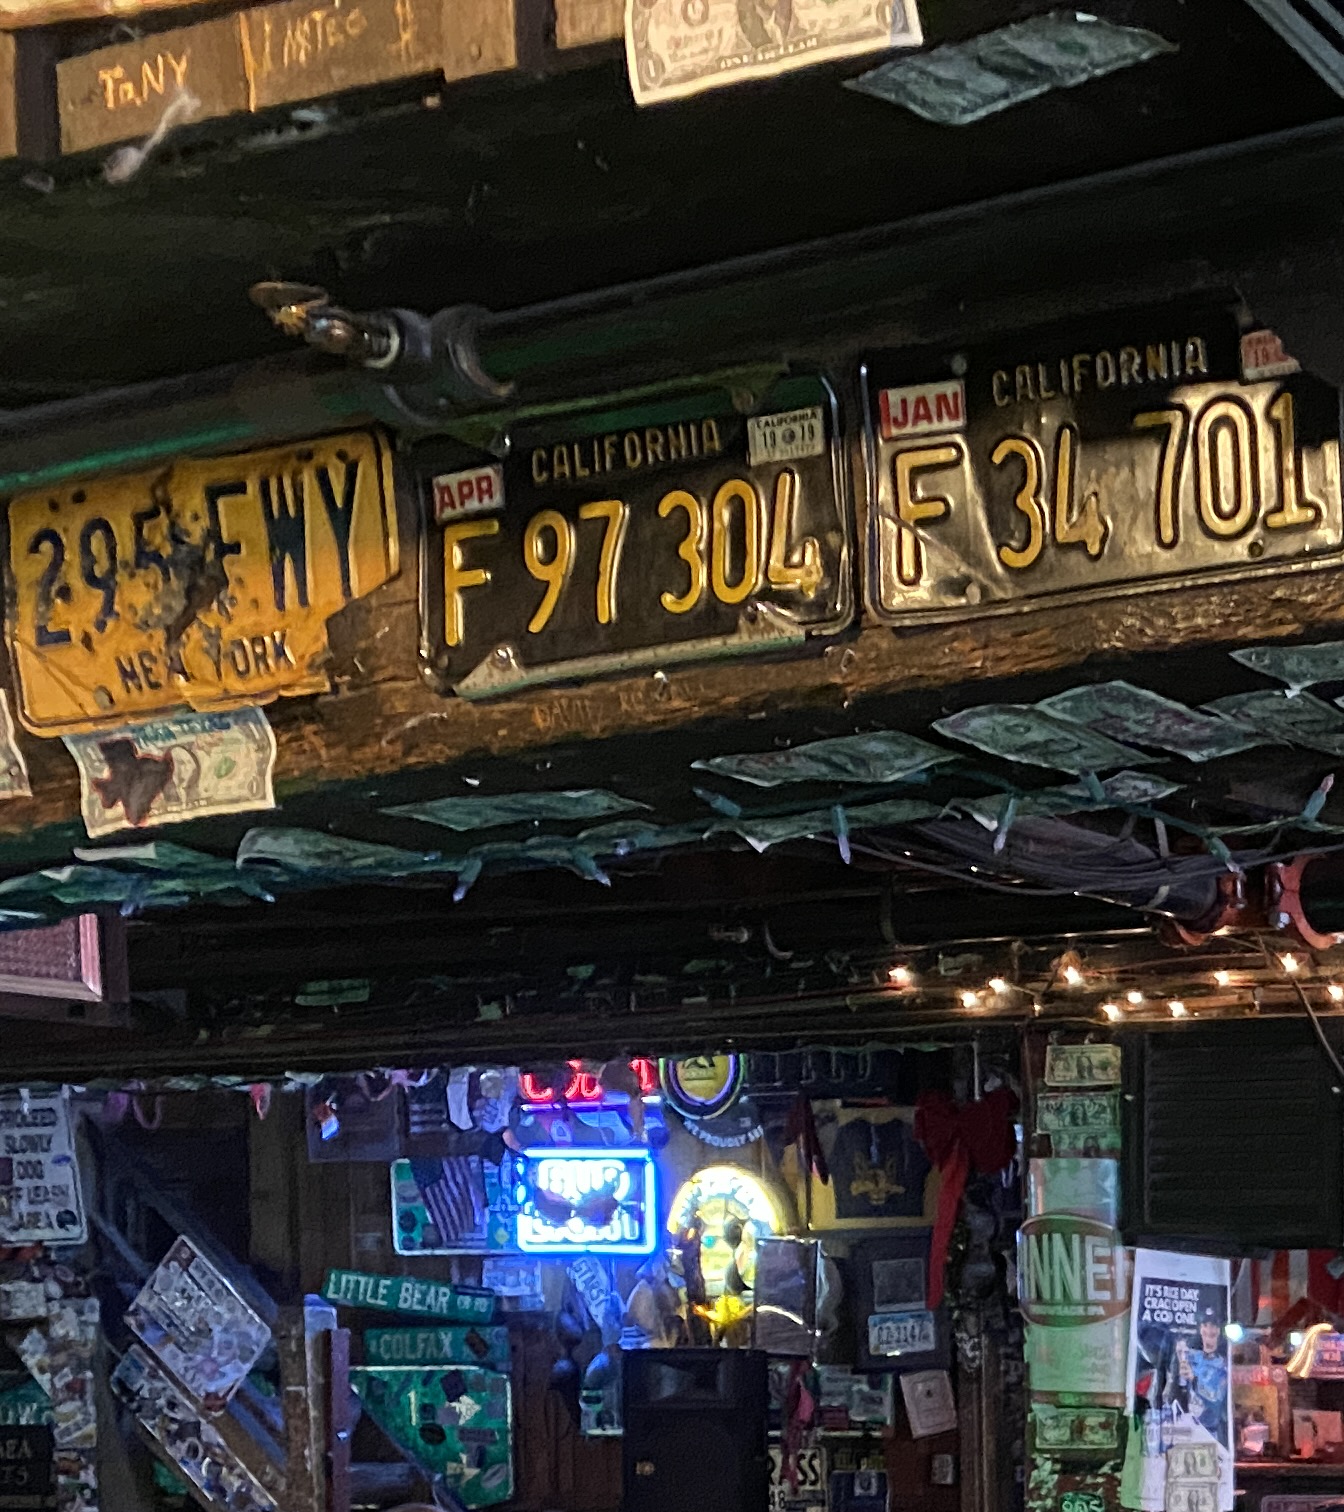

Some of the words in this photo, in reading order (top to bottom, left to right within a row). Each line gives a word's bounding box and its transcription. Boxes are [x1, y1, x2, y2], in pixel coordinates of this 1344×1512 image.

[991, 335, 1209, 408] CALIFORNIA
[890, 391, 962, 430] JAN
[531, 417, 722, 485] CALIFORNIA
[435, 472, 497, 515] APR
[892, 445, 962, 585] F
[991, 425, 1112, 570] 34
[1132, 388, 1318, 552] 701
[444, 518, 500, 648] F
[523, 498, 633, 635] 97
[657, 466, 824, 617] 304
[198, 620, 300, 684] YORK
[325, 1272, 392, 1307] LITTLE
[398, 1282, 451, 1314] BEAR
[379, 1331, 453, 1360] COLFAX
